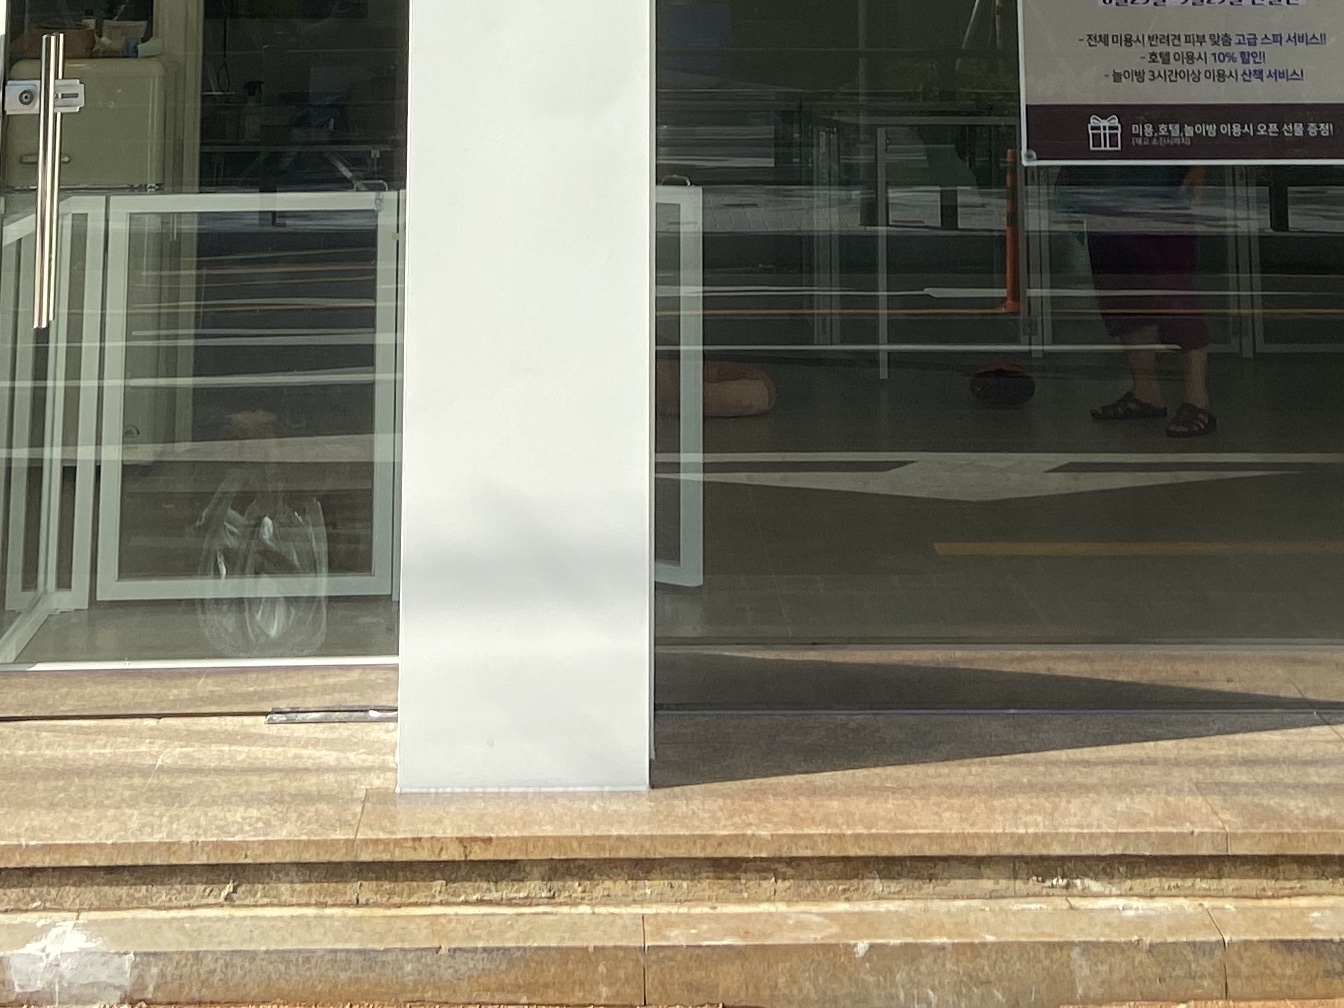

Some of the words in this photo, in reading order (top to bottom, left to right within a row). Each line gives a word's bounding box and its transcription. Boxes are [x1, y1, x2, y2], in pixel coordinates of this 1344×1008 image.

[1111, 33, 1145, 47] 미용시
[1235, 33, 1258, 47] 고급
[1260, 32, 1283, 46] 스파
[1173, 51, 1208, 65] 이용시
[1211, 51, 1237, 64] 10%
[1204, 69, 1239, 83] 이용시
[1220, 123, 1254, 137] 이용시
[1256, 123, 1280, 136] 오픈
